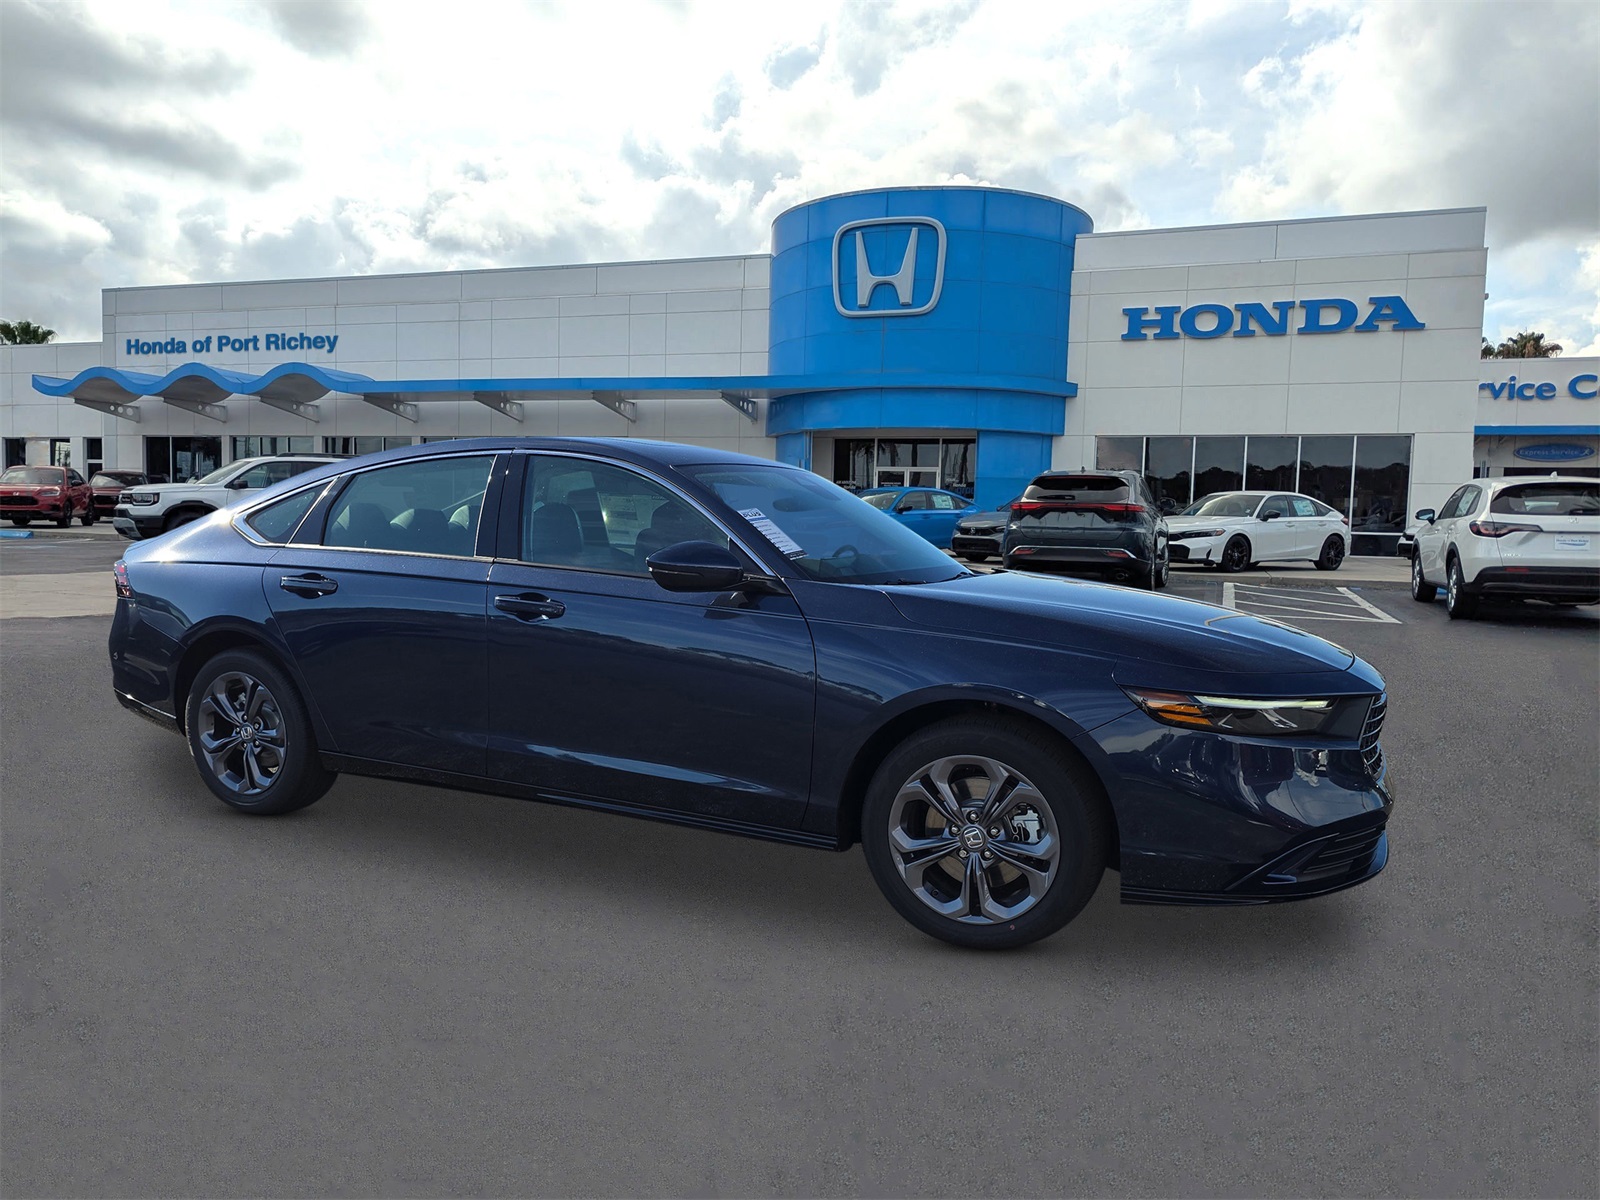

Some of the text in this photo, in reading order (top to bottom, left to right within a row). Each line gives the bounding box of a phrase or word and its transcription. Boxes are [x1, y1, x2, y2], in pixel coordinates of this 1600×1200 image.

[1121, 295, 1426, 341] HONDA
[126, 333, 339, 355] Honda of Port Richey
[1568, 374, 1600, 399] C
[1520, 448, 1548, 456] Express
